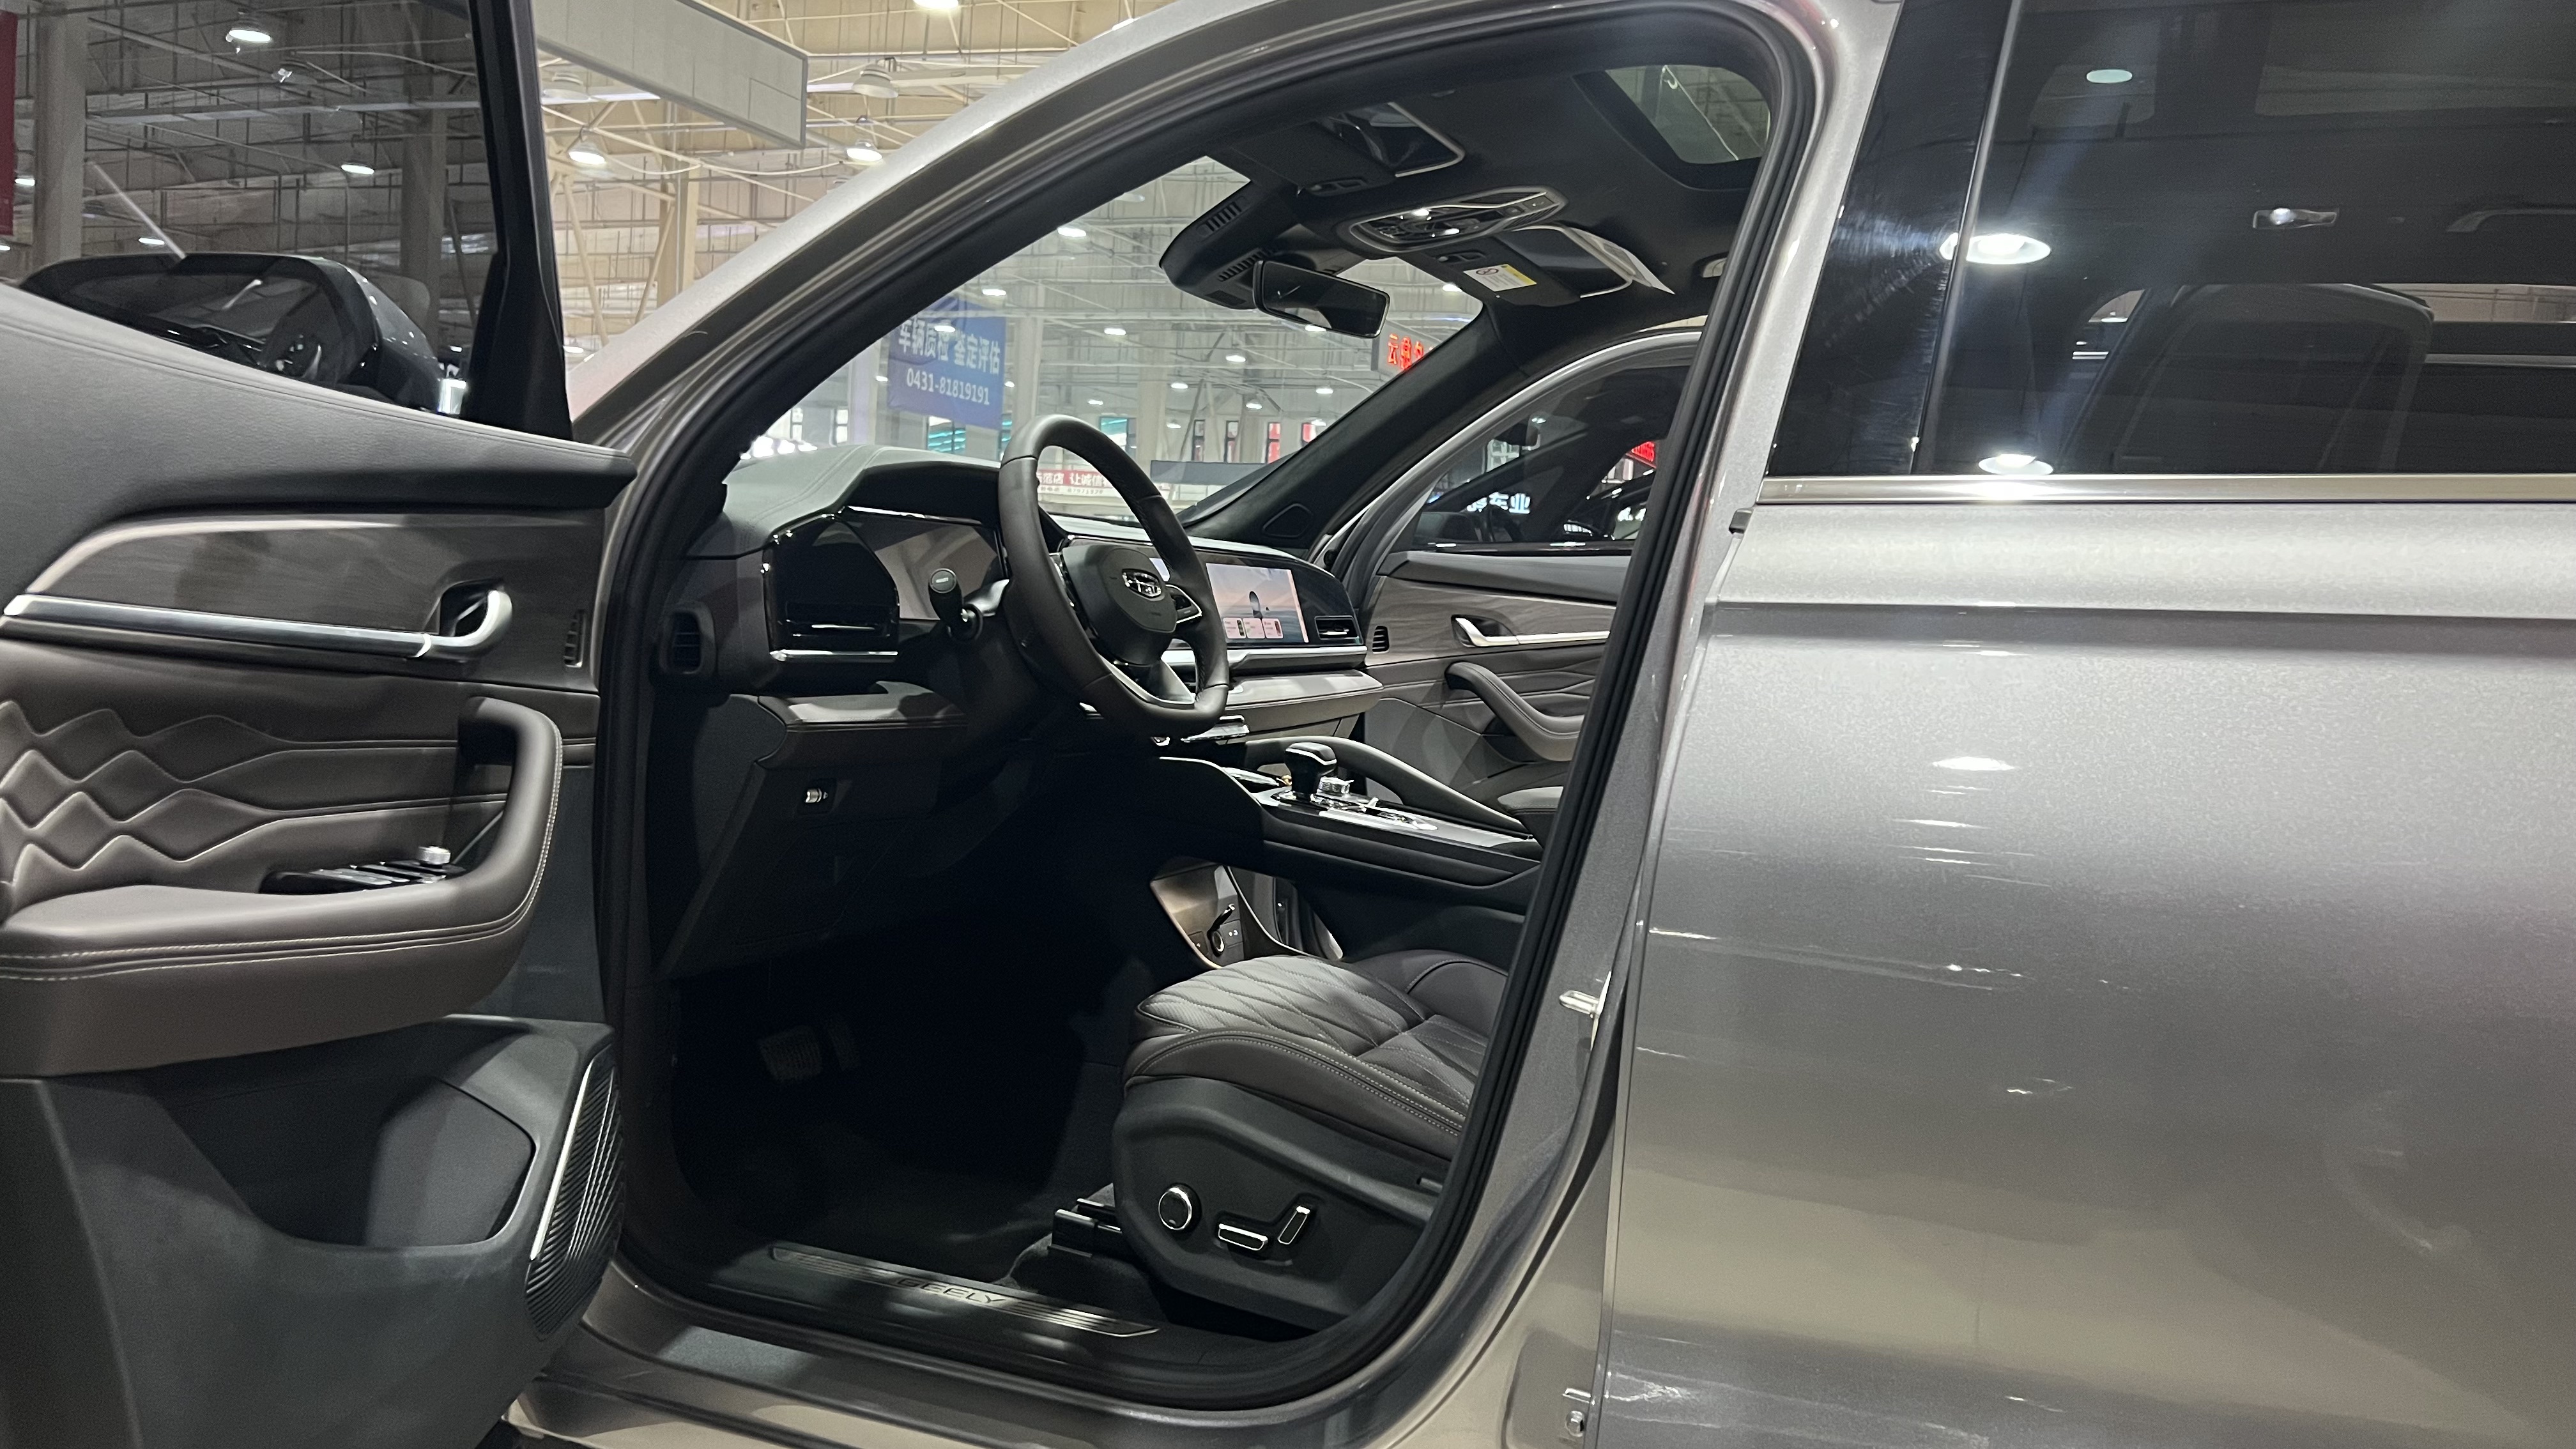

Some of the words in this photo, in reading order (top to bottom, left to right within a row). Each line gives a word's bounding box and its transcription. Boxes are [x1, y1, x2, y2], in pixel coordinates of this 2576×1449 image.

[954, 328, 1000, 374] 鉴定评估
[907, 367, 990, 405] 0431-81819191
[898, 1278, 1007, 1303] GEELY
